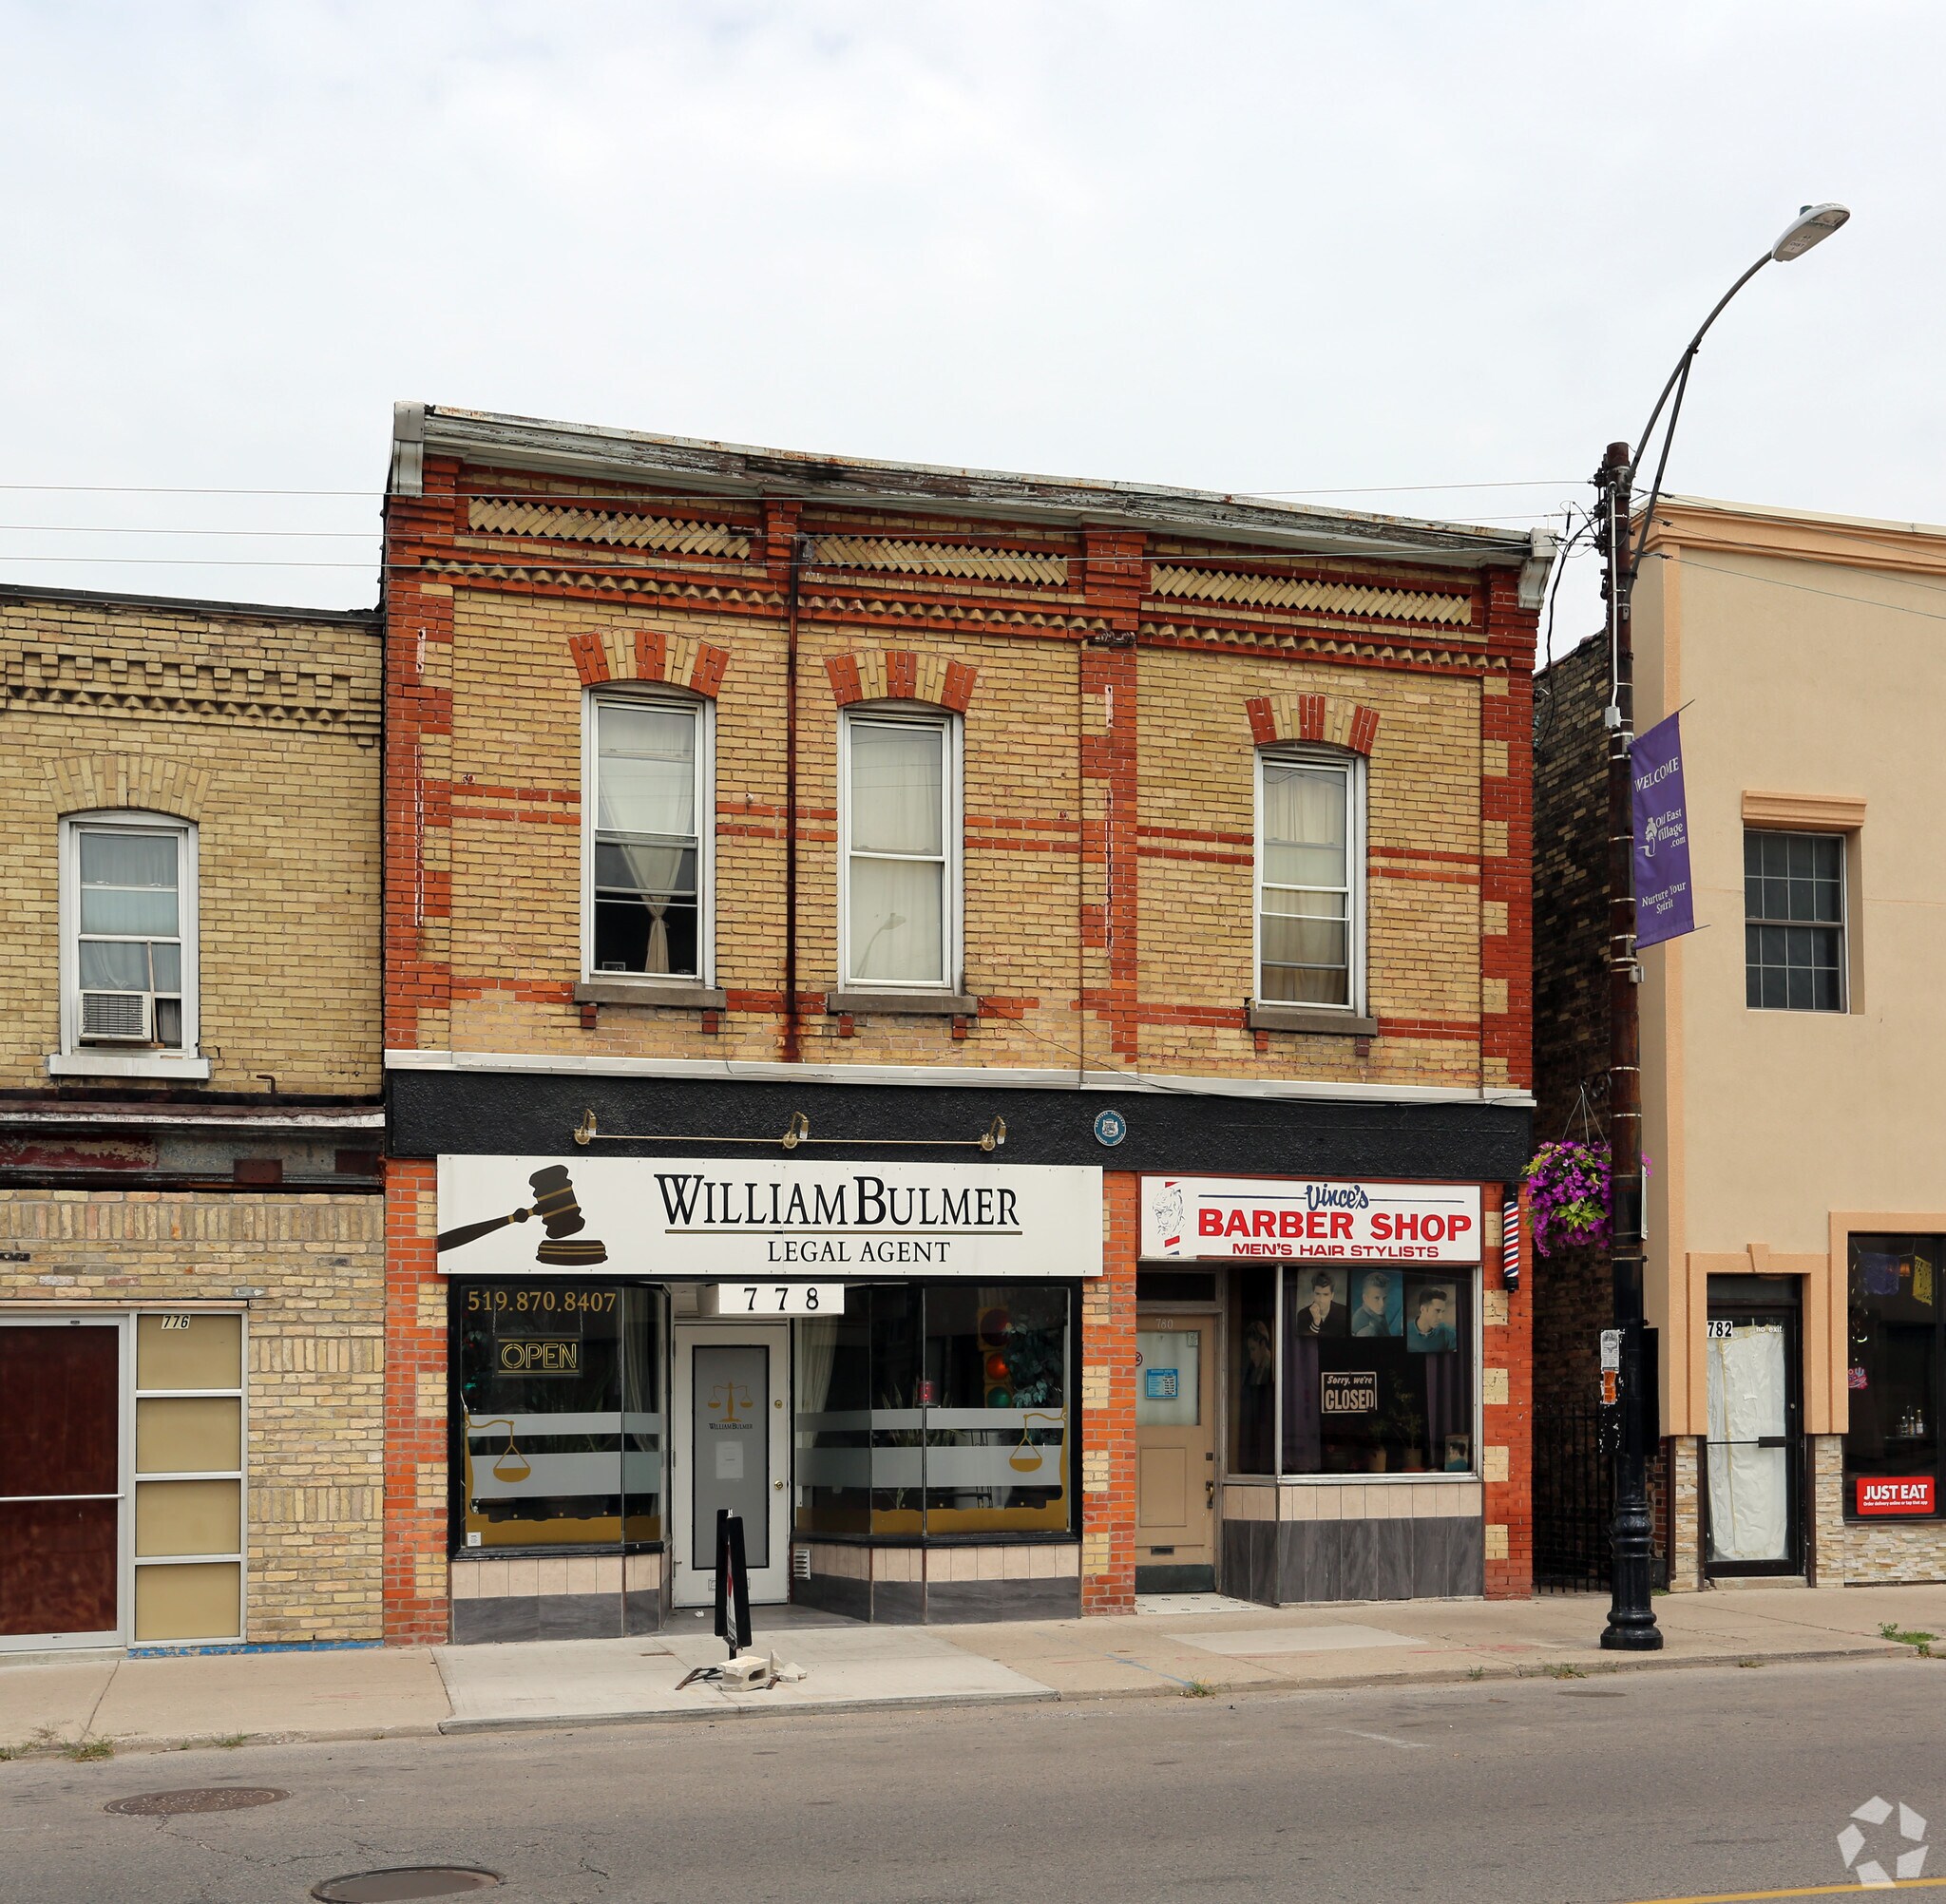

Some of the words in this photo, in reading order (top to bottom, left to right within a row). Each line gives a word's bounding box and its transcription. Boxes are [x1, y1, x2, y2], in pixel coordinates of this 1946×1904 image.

[1634, 757, 1679, 792] WELCOME
[1667, 809, 1682, 823] East
[1658, 823, 1684, 842] Village
[1670, 836, 1686, 848] .com
[1642, 889, 1669, 907] Nurture
[1669, 882, 1686, 895] Your
[1656, 898, 1673, 914] Spirit
[1305, 1183, 1368, 1211] Vince's
[1198, 1208, 1354, 1240] BARBER
[1370, 1212, 1472, 1242] SHOP
[767, 1240, 851, 1263] LEGAL
[859, 1241, 951, 1263] AGENT
[1231, 1243, 1293, 1256] MEN'S
[1299, 1244, 1345, 1257] HAIR
[1350, 1245, 1440, 1258] STYLISTS
[467, 1290, 617, 1313] 519.870.8407
[163, 1315, 189, 1328] 776
[1155, 1318, 1173, 1330] 780
[1768, 1324, 1783, 1333] exit
[1708, 1322, 1732, 1338] 782
[501, 1342, 577, 1369] OPEN
[1326, 1375, 1351, 1387] Sorry,
[1353, 1376, 1373, 1384] we're
[1325, 1389, 1375, 1410] CLOSED
[1863, 1485, 1898, 1500] JUST
[1900, 1484, 1928, 1499] EAT
